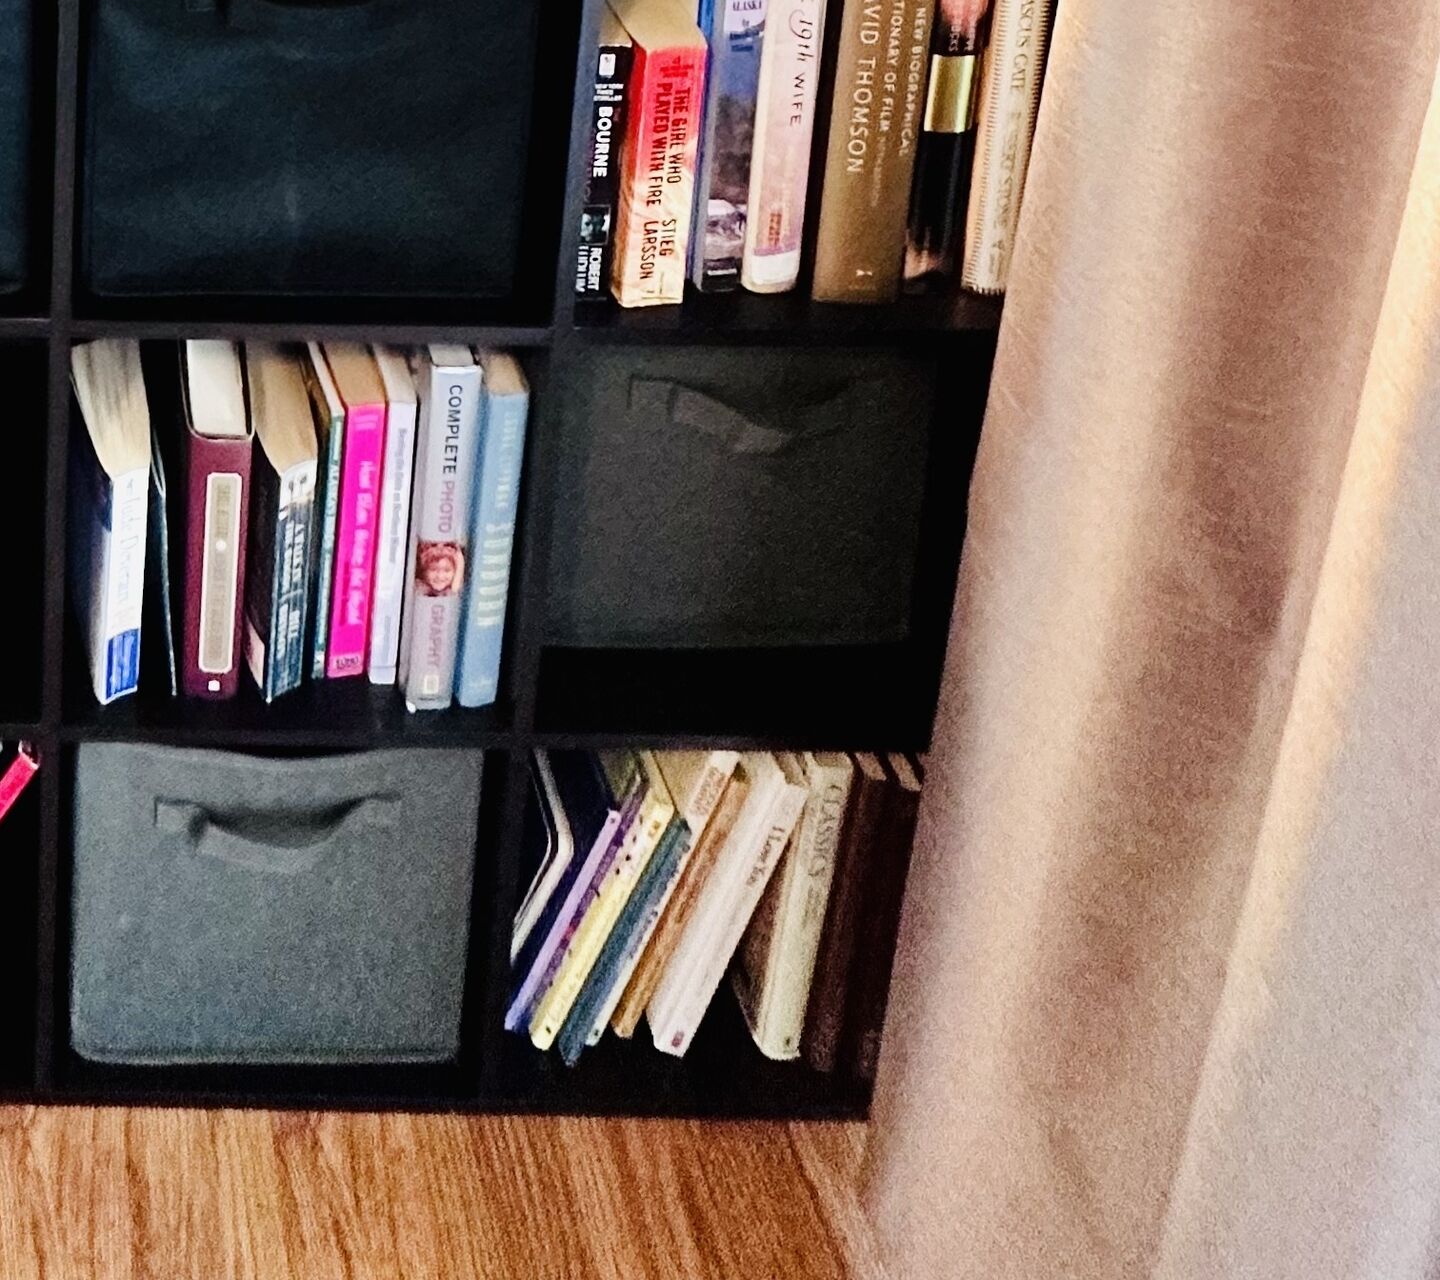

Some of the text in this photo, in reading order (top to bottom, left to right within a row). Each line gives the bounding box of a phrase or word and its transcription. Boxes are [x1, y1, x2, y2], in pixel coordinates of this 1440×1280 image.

[786, 9, 817, 62] 19th
[912, 7, 927, 40] NEW
[789, 71, 806, 127] WIFE
[883, 72, 897, 92] OF
[898, 45, 923, 157] BIOGRAPHICAL
[1010, 54, 1028, 96] GATE
[592, 106, 613, 178] BOURNE
[667, 87, 690, 184] THE GIRL WHO
[846, 55, 876, 175] THOMSON
[879, 97, 894, 133] FILM
[647, 82, 672, 208] PLAYED WITH FIRE
[640, 220, 658, 280] LARSSON
[659, 218, 677, 257] STIEG
[587, 247, 603, 291] ROBERT
[437, 384, 464, 534] COMPLETE PHOTO
[426, 604, 445, 668] GRAPHY
